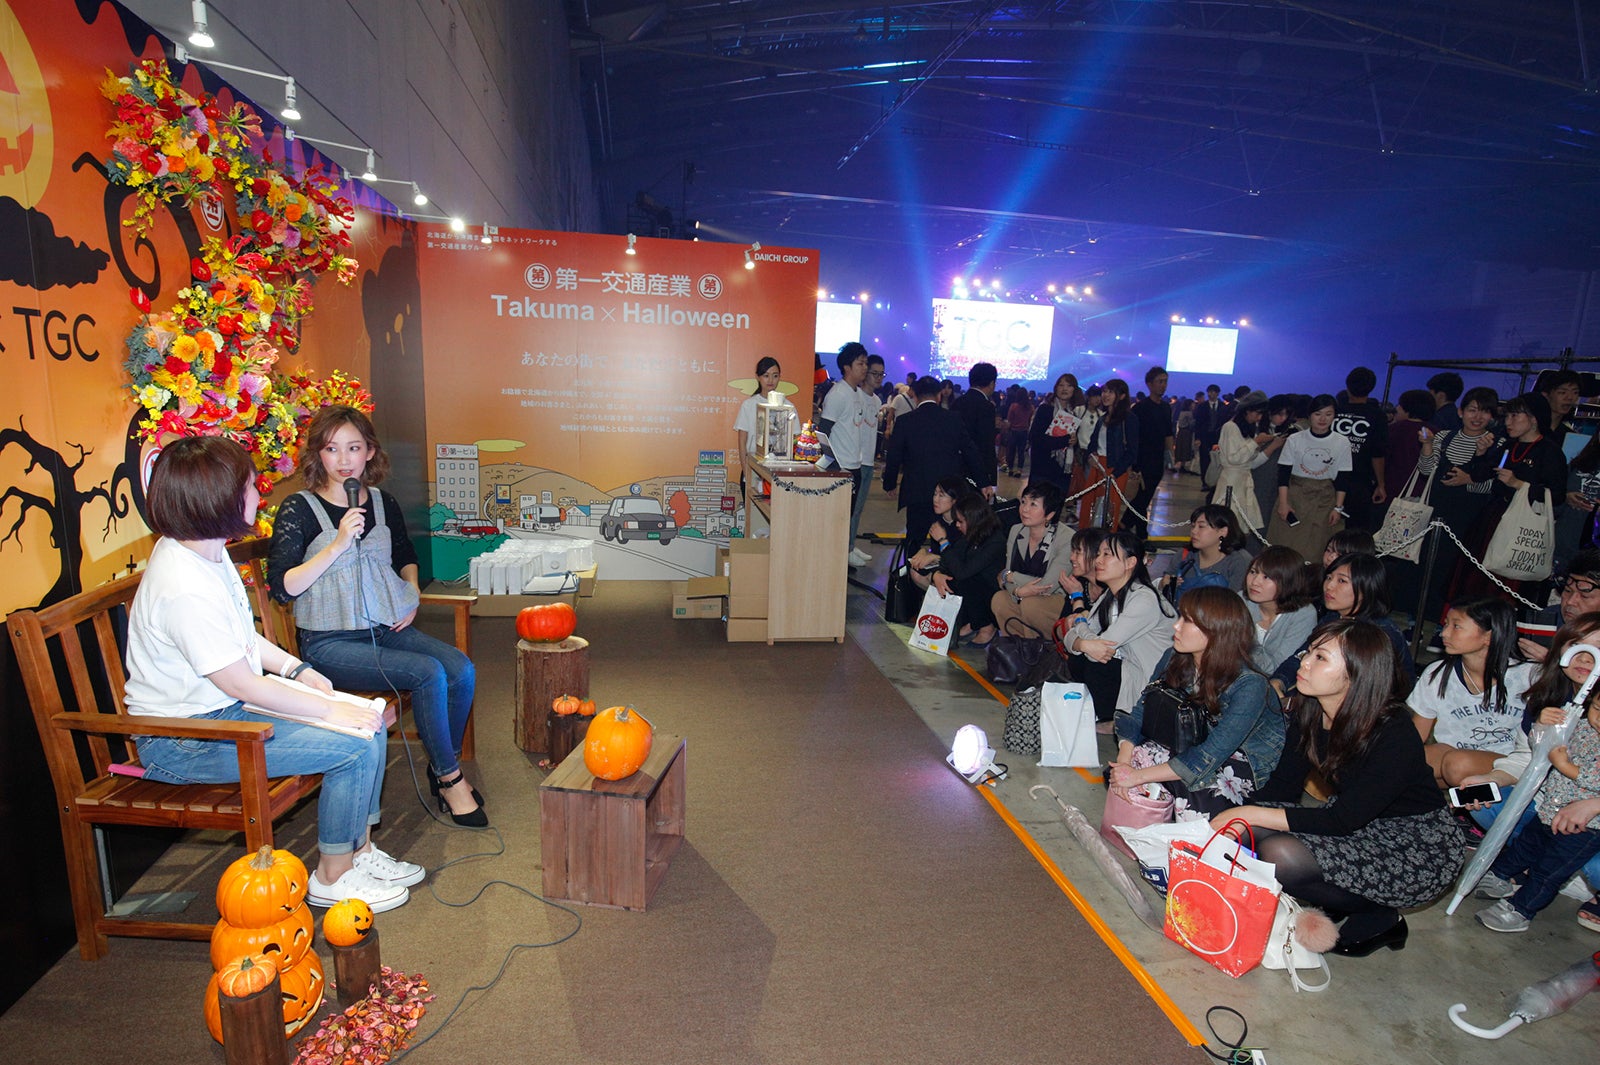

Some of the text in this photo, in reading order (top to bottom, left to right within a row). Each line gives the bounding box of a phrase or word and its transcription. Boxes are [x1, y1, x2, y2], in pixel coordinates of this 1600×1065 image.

[427, 231, 558, 246] 北海道から沖縄ま国をネットワークする
[754, 253, 809, 264] DAIICHI GROUP
[555, 267, 692, 298] 第一交通産業
[490, 294, 595, 321] Takuma
[622, 302, 750, 329] Halloween
[12, 306, 100, 362] TGC
[953, 315, 1031, 353] TGC
[1519, 526, 1546, 539] TODAY
[1514, 536, 1547, 549] SPECIAL
[1506, 559, 1537, 574] SPECIAL
[1450, 705, 1473, 720] THE
